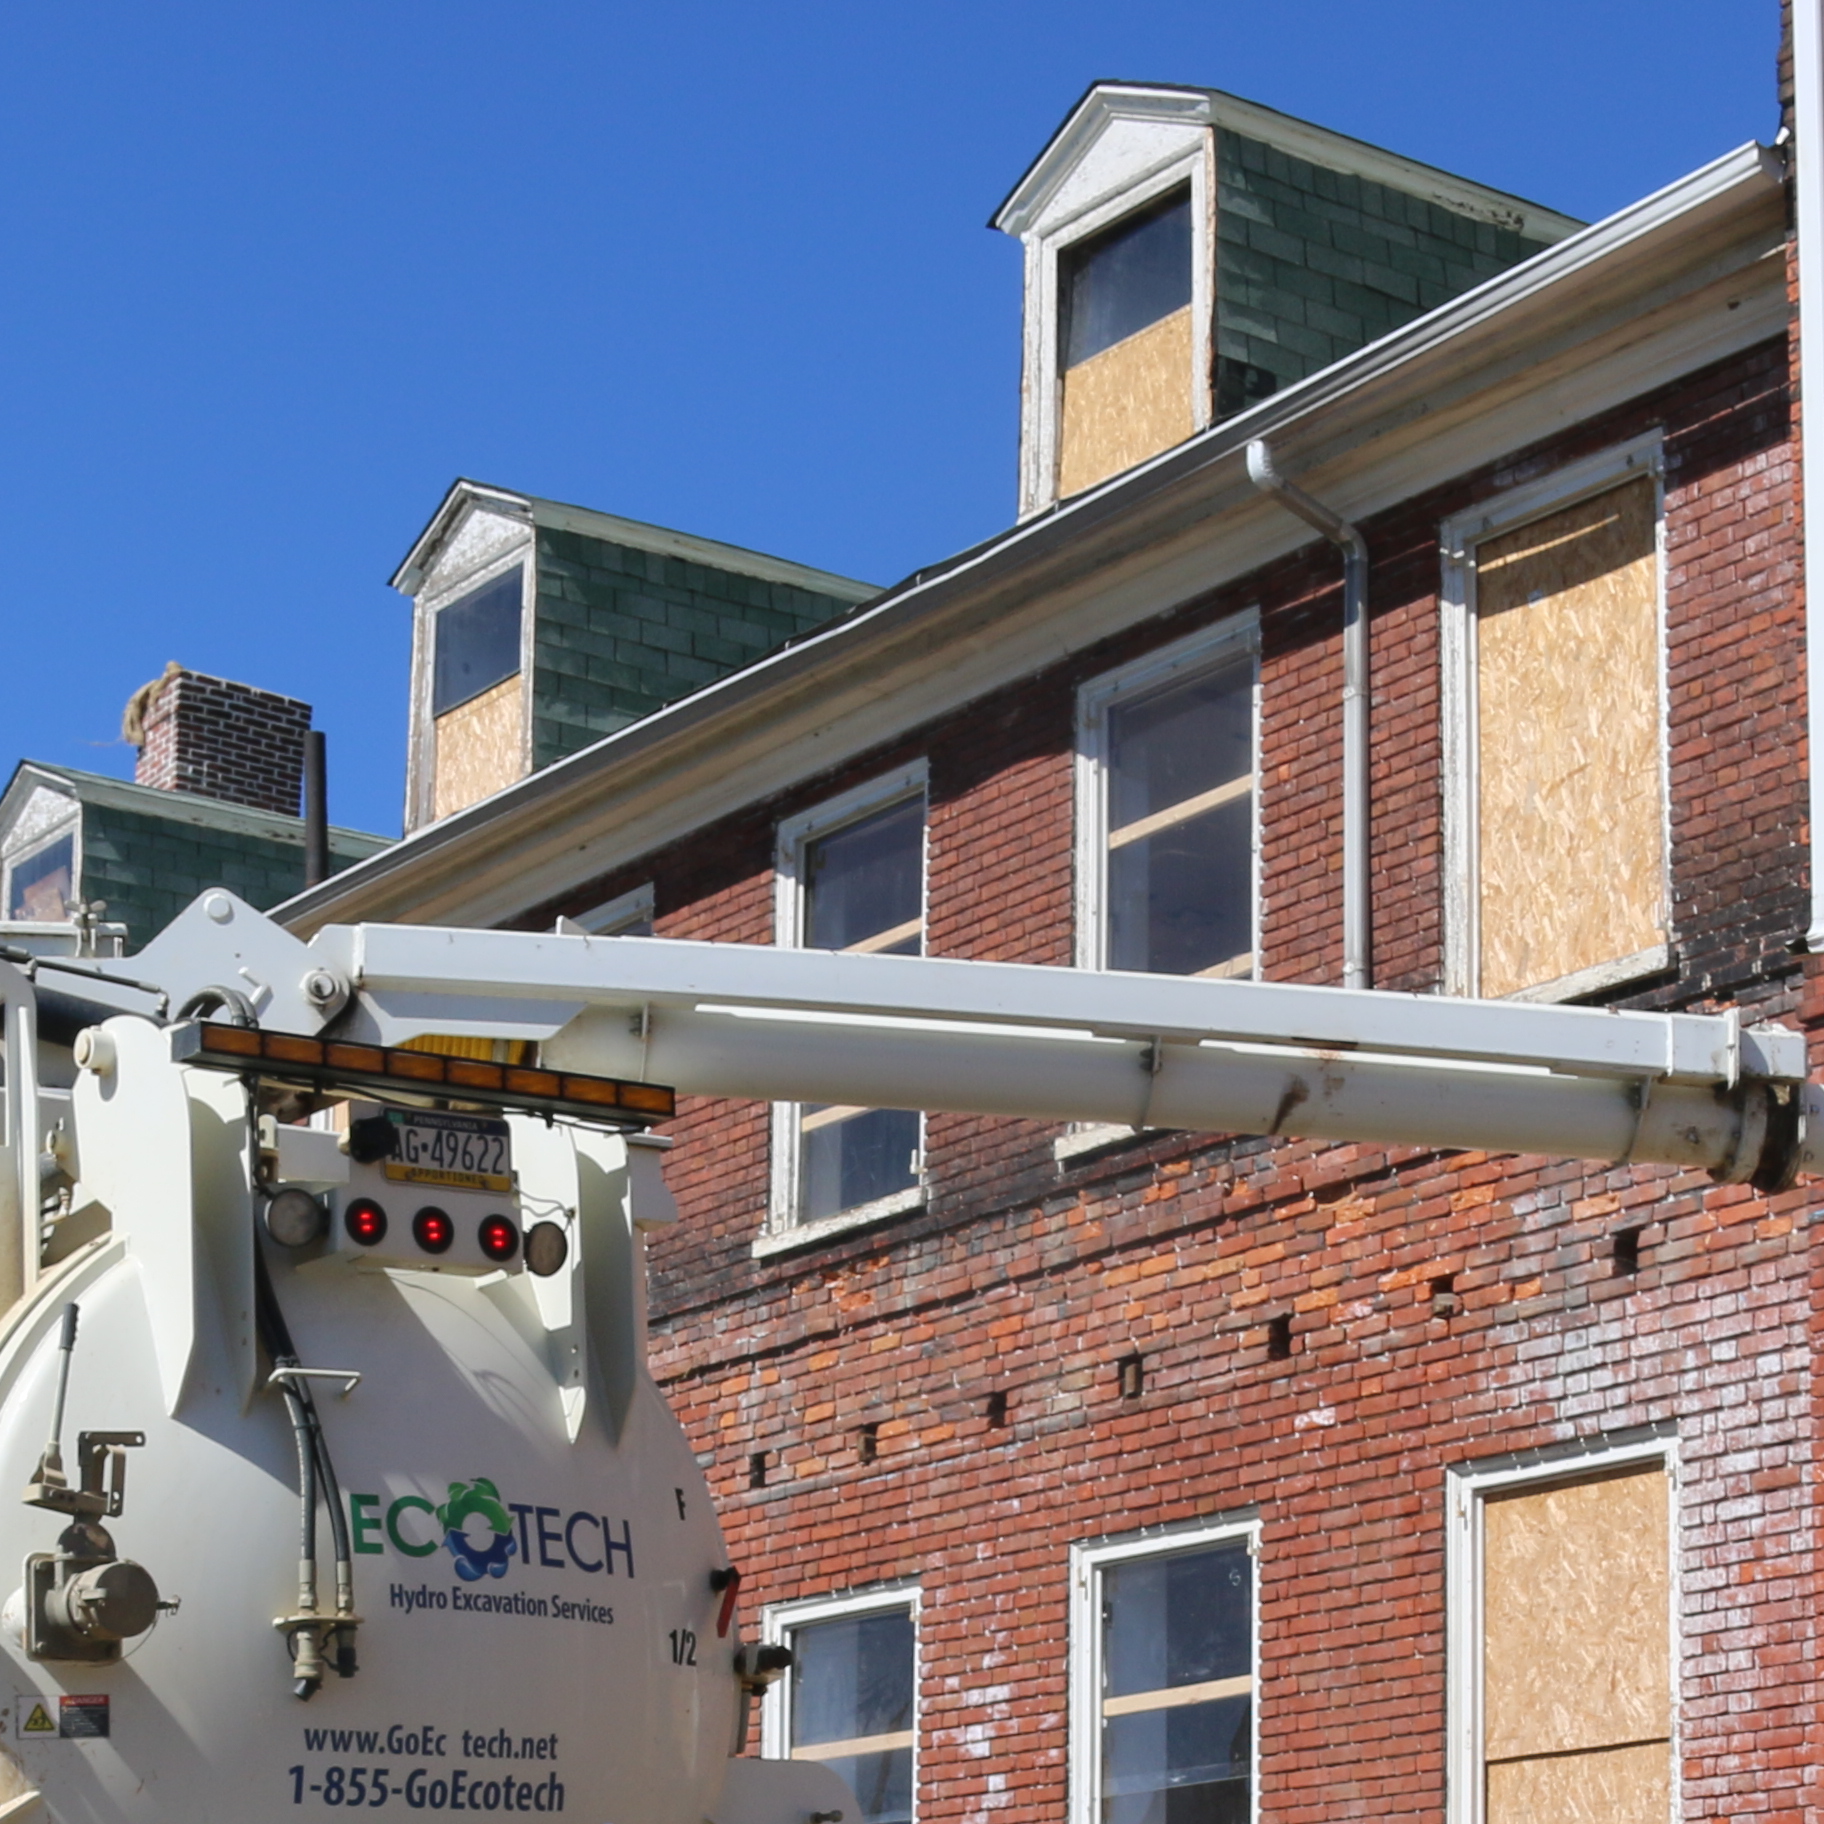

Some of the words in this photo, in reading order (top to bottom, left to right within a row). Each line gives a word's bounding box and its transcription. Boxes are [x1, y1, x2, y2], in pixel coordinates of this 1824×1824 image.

[674, 1487, 686, 1521] F
[349, 1477, 635, 1582] ECOTECH
[389, 1583, 447, 1615] Hydro
[452, 1586, 548, 1617] Excavation
[551, 1598, 615, 1625] Services
[668, 1628, 698, 1667] 1/2
[288, 1764, 565, 1812] 1-855-GoEcotech
